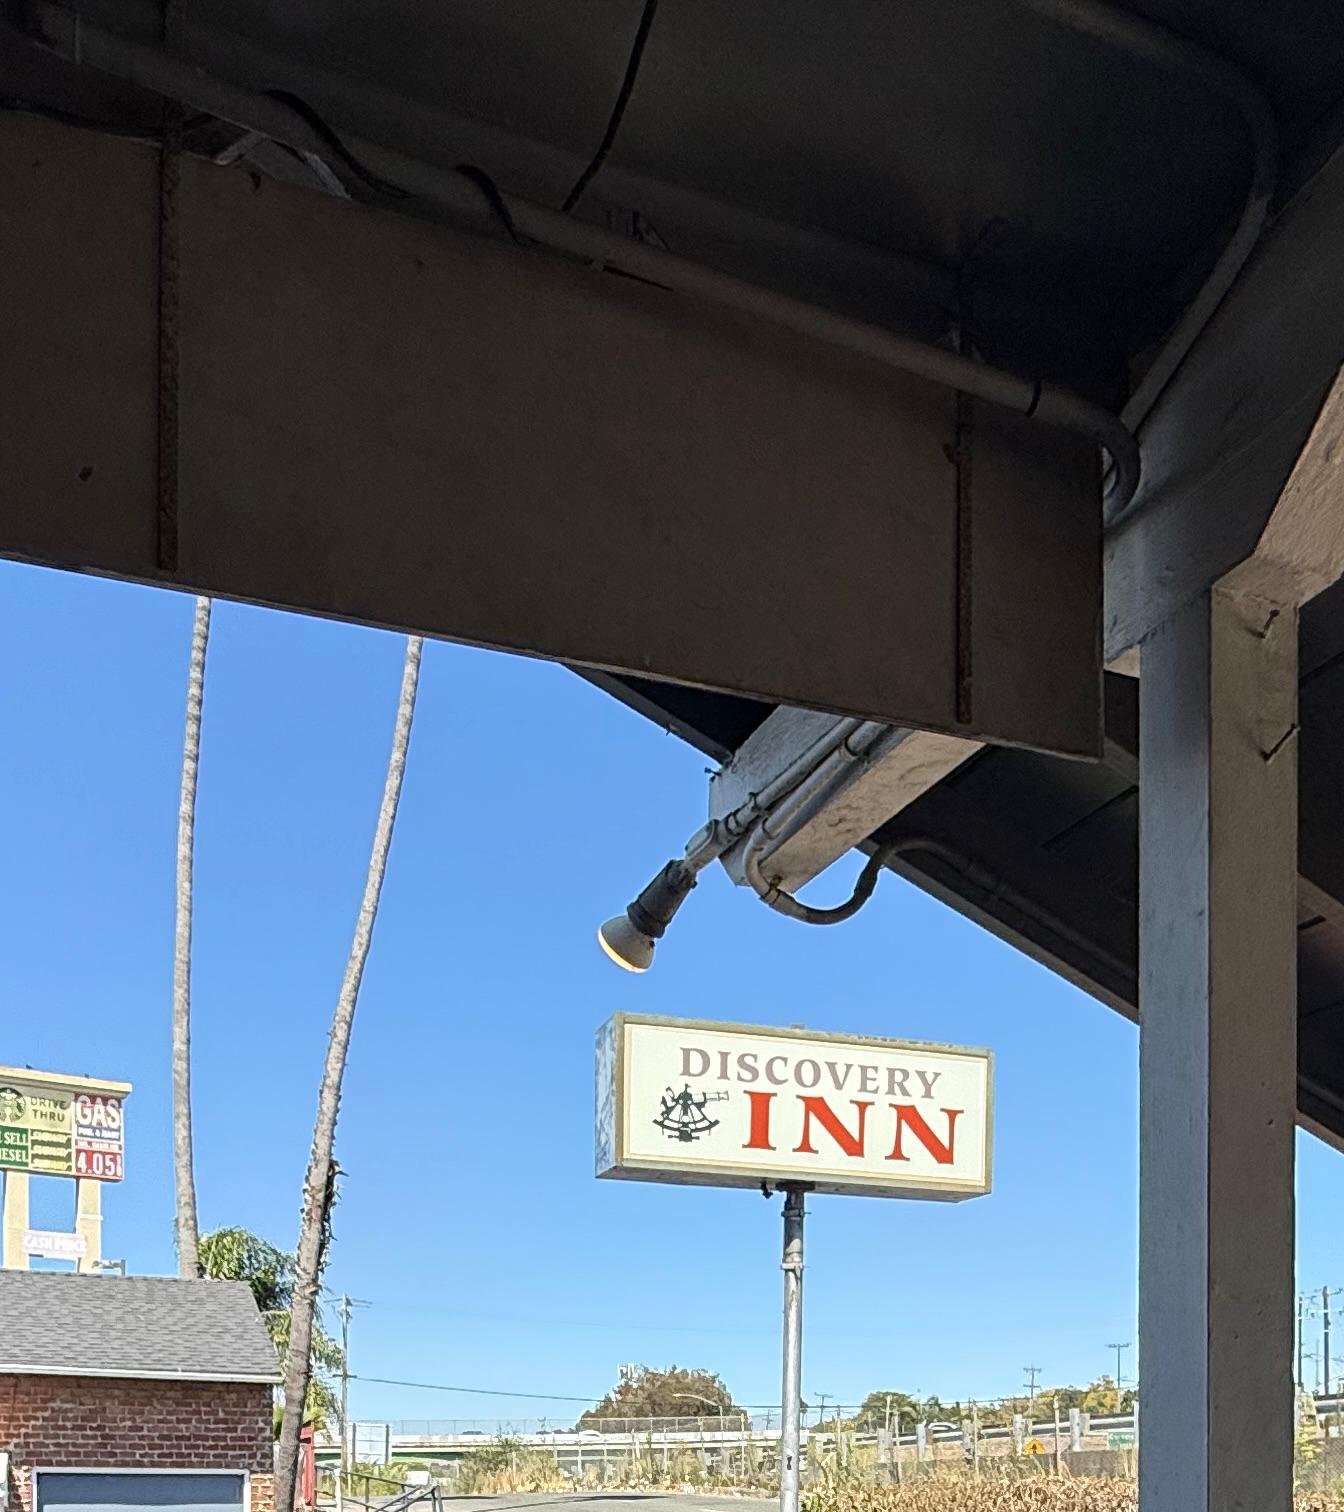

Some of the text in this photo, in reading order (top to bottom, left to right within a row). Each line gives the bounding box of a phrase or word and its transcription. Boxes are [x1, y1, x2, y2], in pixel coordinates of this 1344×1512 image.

[679, 1046, 942, 1100] DISCOVERY
[31, 1097, 67, 1110] DRIVE
[32, 1109, 65, 1122] THRU
[76, 1095, 121, 1129] GAS
[3, 1131, 28, 1145] SELL
[742, 1090, 965, 1166] INN
